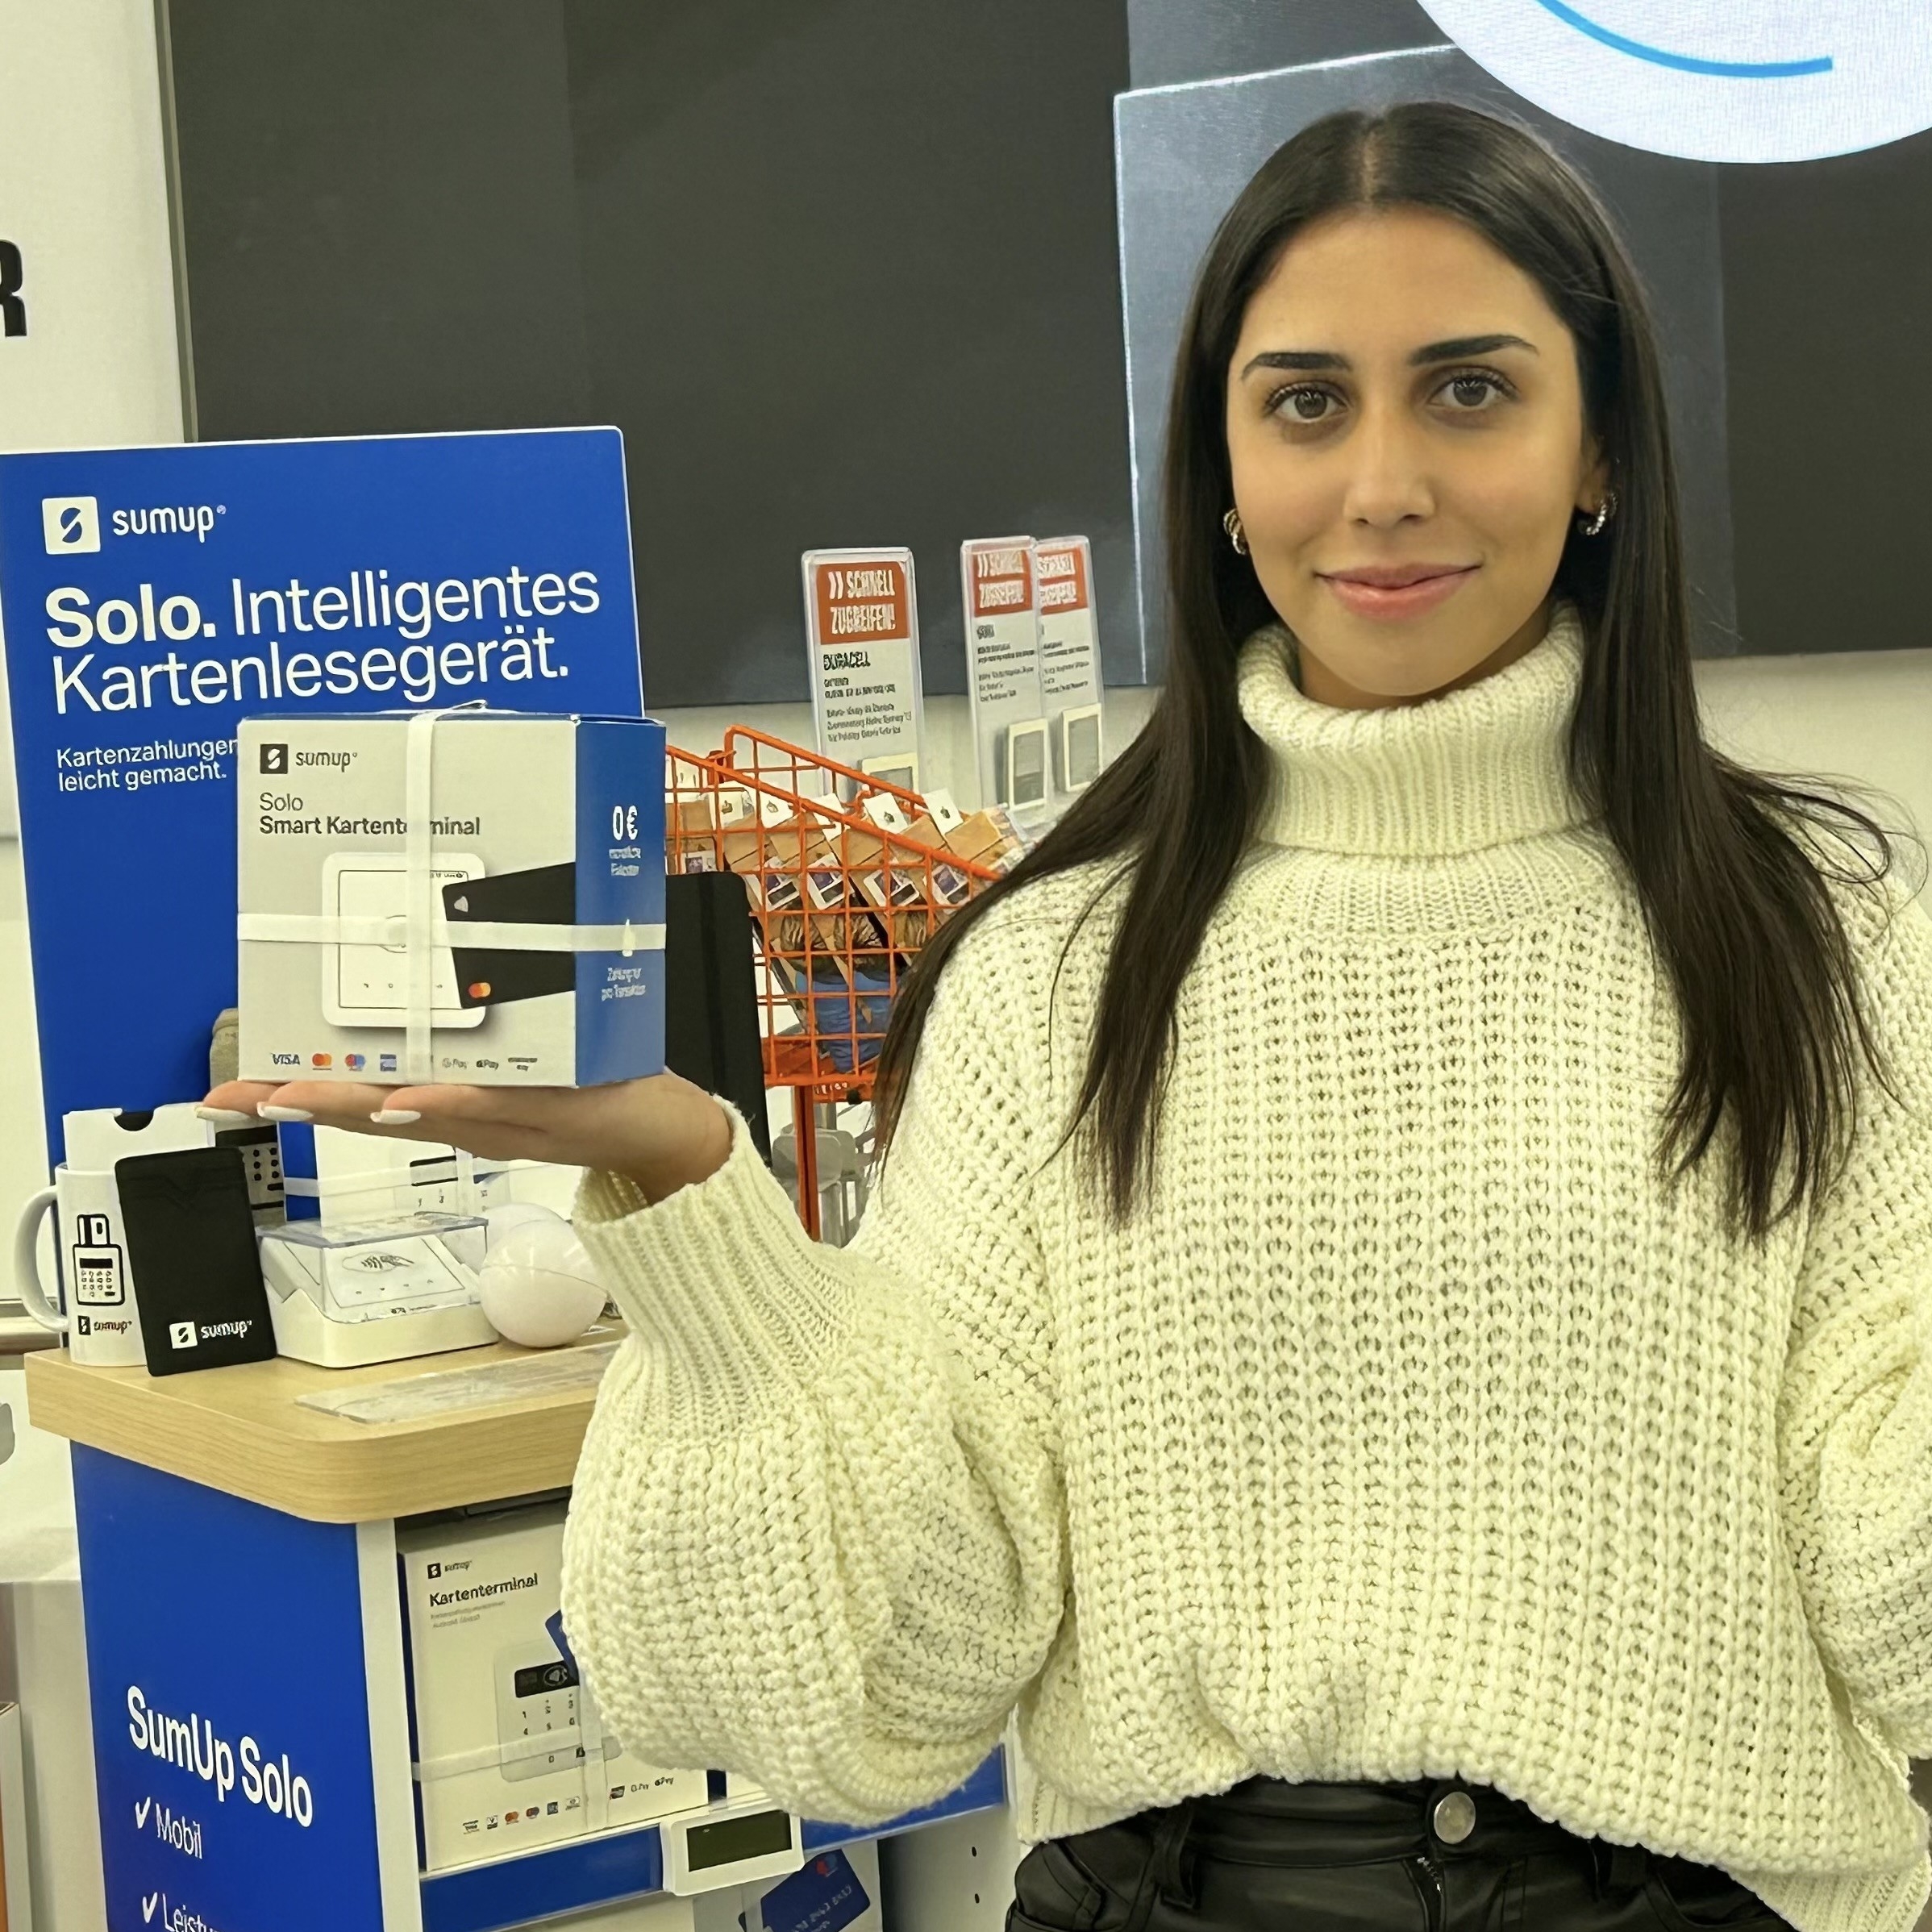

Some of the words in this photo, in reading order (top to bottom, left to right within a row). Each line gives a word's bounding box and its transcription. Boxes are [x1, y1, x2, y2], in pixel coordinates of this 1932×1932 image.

[112, 505, 214, 543] sumup
[44, 583, 218, 649] Solo.
[231, 566, 602, 639] Intelligentes
[52, 626, 569, 715] Kartenlesegerät.
[58, 771, 120, 792] leicht
[124, 760, 227, 791] gemacht.
[295, 752, 351, 772] sumup
[259, 792, 304, 811] Solo
[259, 814, 323, 835] Smart
[327, 814, 481, 836] Kartentminal
[429, 1572, 539, 1607] Kartenterminal
[127, 1685, 235, 1802] SumUp
[240, 1736, 313, 1827] Solo
[156, 1803, 202, 1859] Mobil
